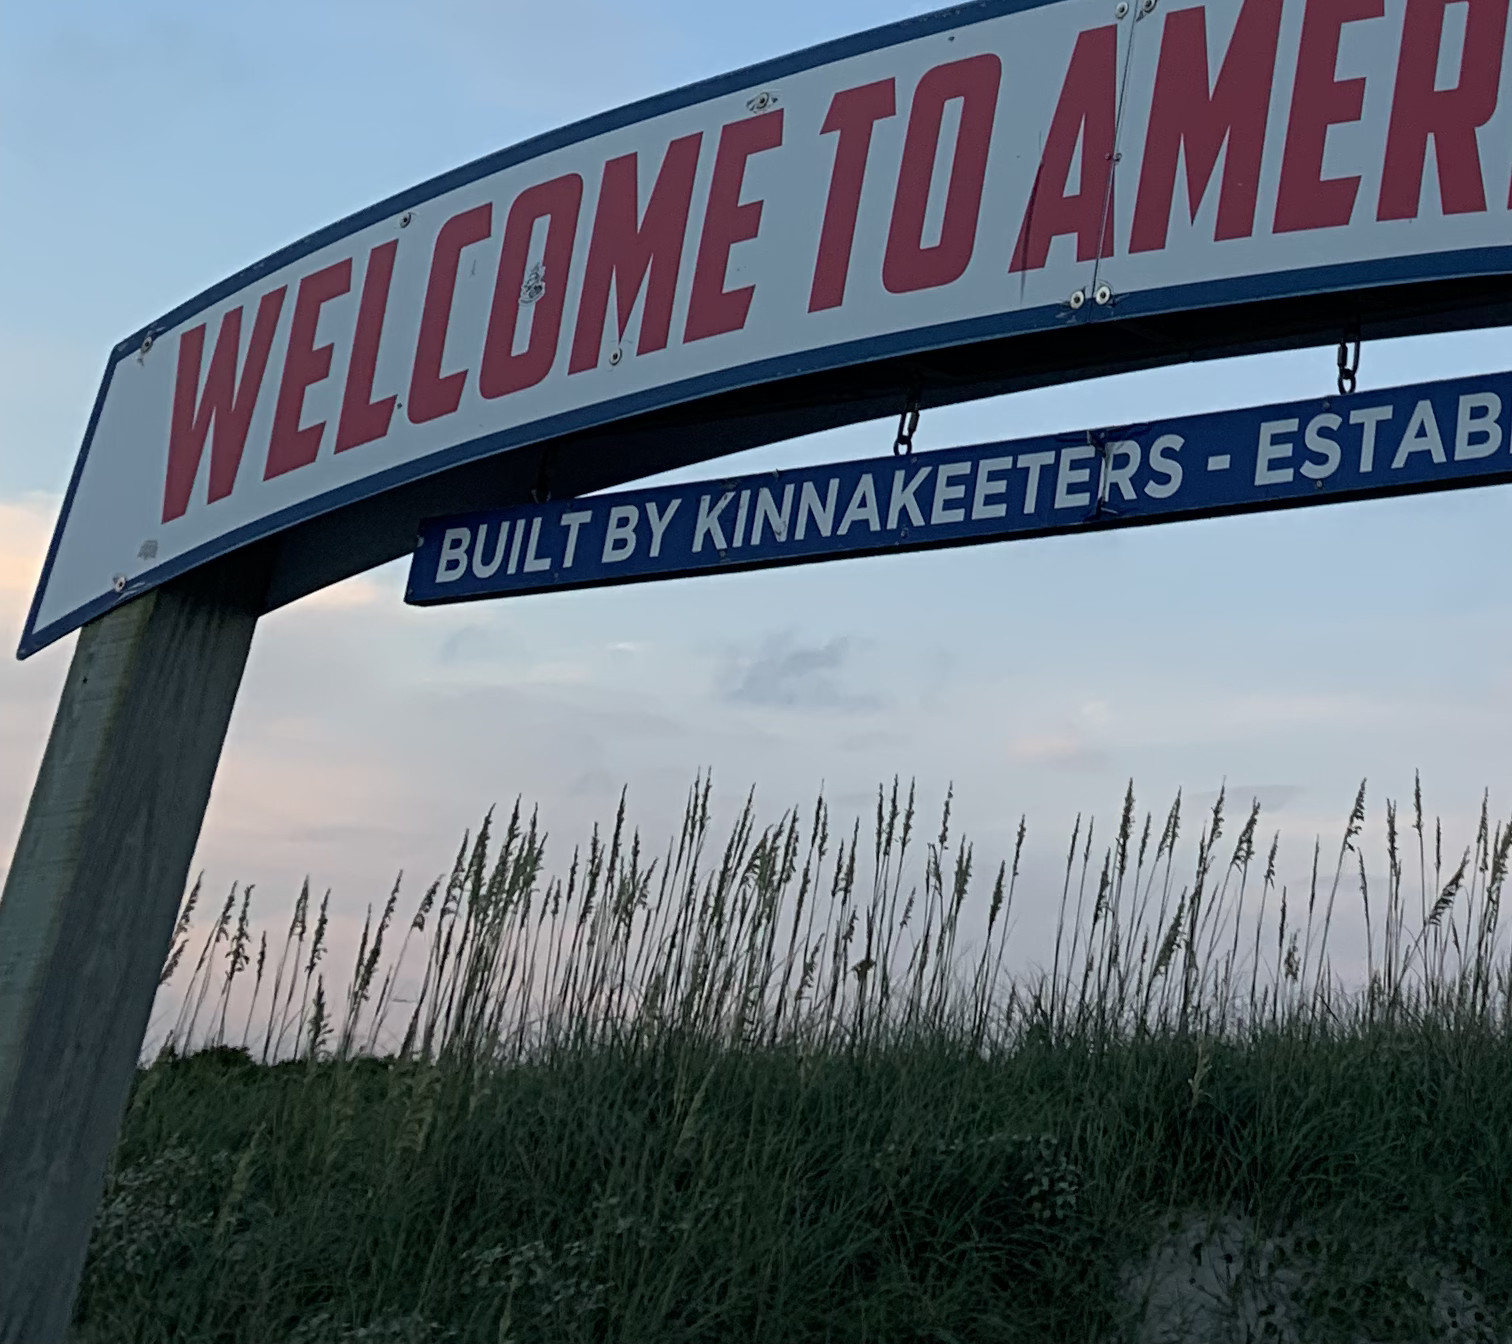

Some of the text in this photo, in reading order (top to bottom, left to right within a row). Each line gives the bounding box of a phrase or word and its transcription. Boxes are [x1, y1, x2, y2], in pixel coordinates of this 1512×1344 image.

[162, 108, 784, 525] WELCOME
[808, 52, 1002, 313] TO
[435, 510, 593, 584] BUILT
[601, 505, 671, 563] BY
[692, 434, 1185, 552] KINNAKEETERS
